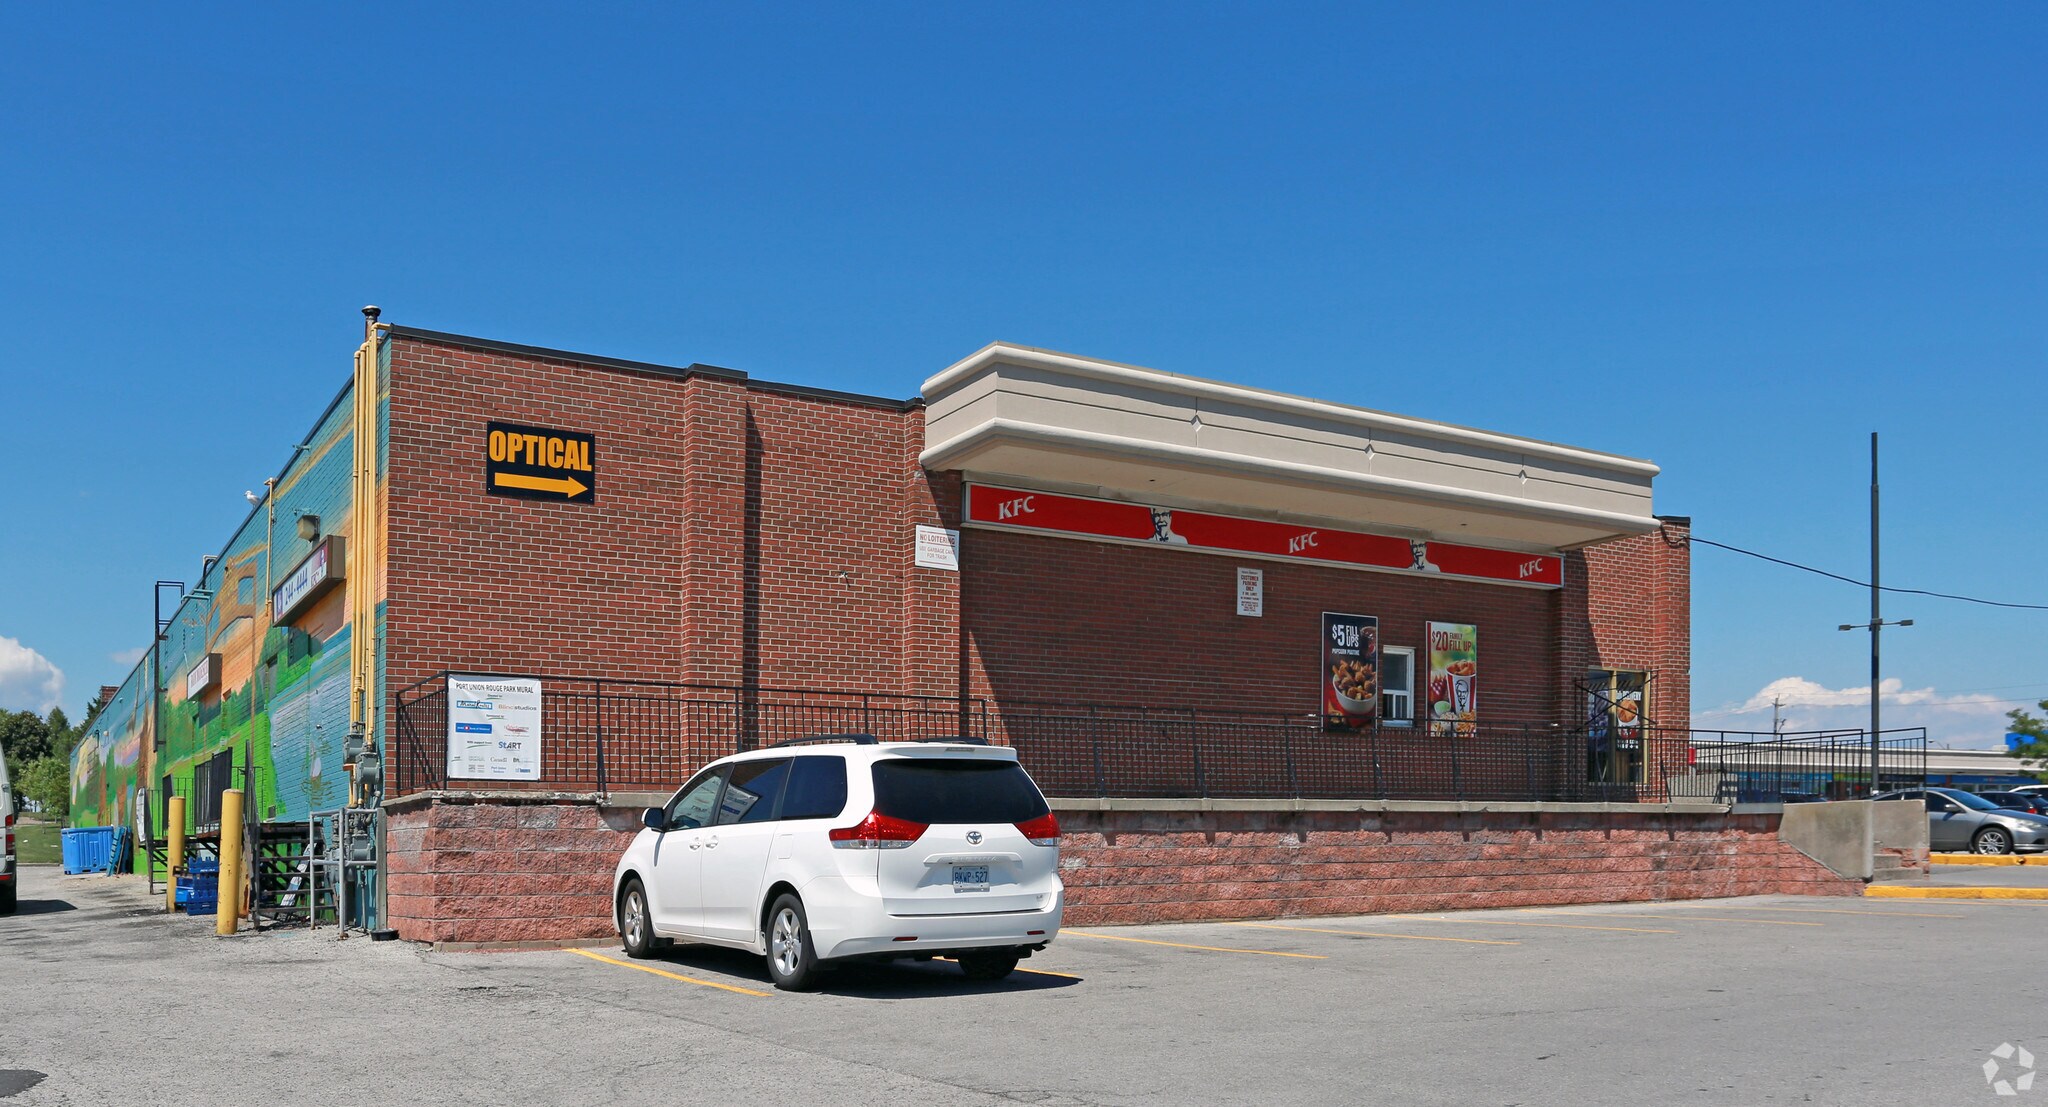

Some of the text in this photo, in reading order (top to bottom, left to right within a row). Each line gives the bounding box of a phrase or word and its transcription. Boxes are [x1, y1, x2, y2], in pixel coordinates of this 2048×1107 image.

[489, 430, 592, 472] OPTICAL
[998, 495, 1035, 520] KFC
[928, 534, 955, 545] LOITERING
[1288, 531, 1318, 554] KFC
[1519, 558, 1543, 579] KFC
[1332, 624, 1345, 647] $5
[1345, 625, 1359, 637] FILL
[1346, 636, 1359, 648] UPS
[1431, 631, 1448, 651] $20
[1449, 639, 1472, 651] FILL UP
[456, 683, 469, 691] PORT
[470, 683, 485, 691] UNION
[486, 684, 502, 692] ROUGE
[517, 686, 533, 694] MURAL
[498, 741, 521, 750] StART
[975, 871, 988, 883] 527
